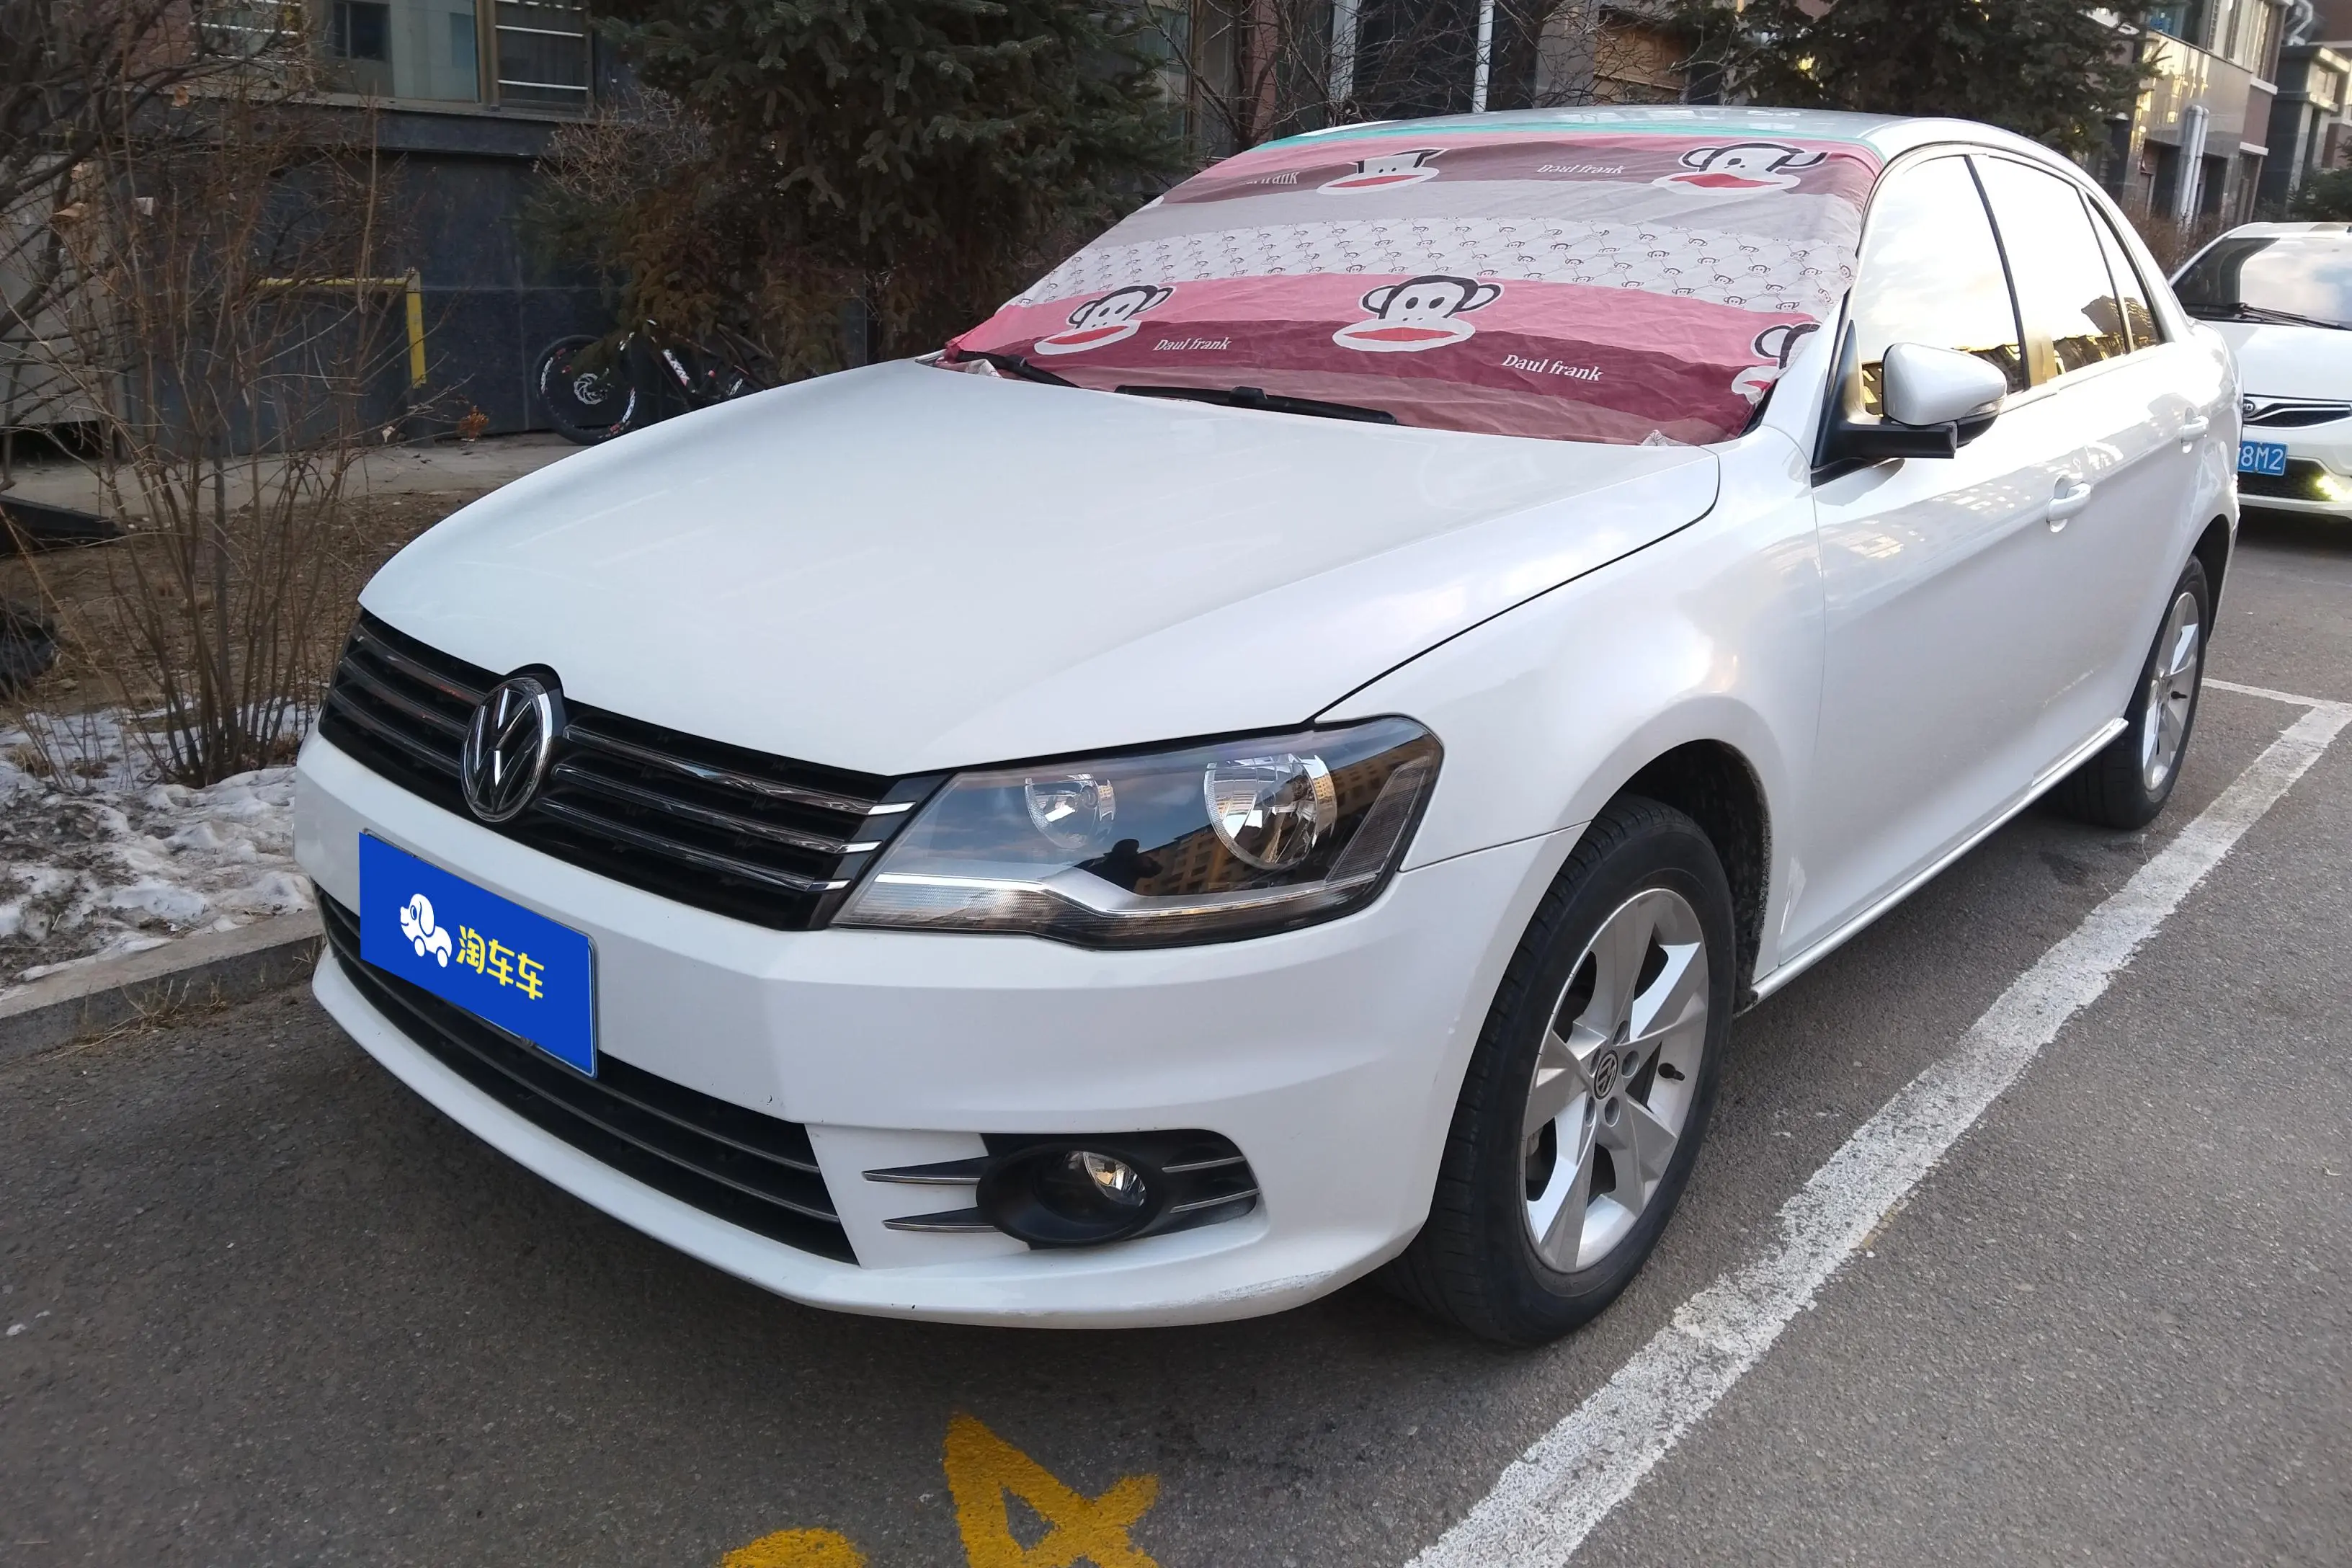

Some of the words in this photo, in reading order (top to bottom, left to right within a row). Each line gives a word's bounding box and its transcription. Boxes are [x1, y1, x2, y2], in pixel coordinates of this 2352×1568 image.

[1577, 164, 1626, 174] frank
[1188, 337, 1232, 350] frank
[1500, 354, 1549, 373] Daul
[1548, 360, 1604, 381] frank
[2240, 445, 2284, 471] 8M2
